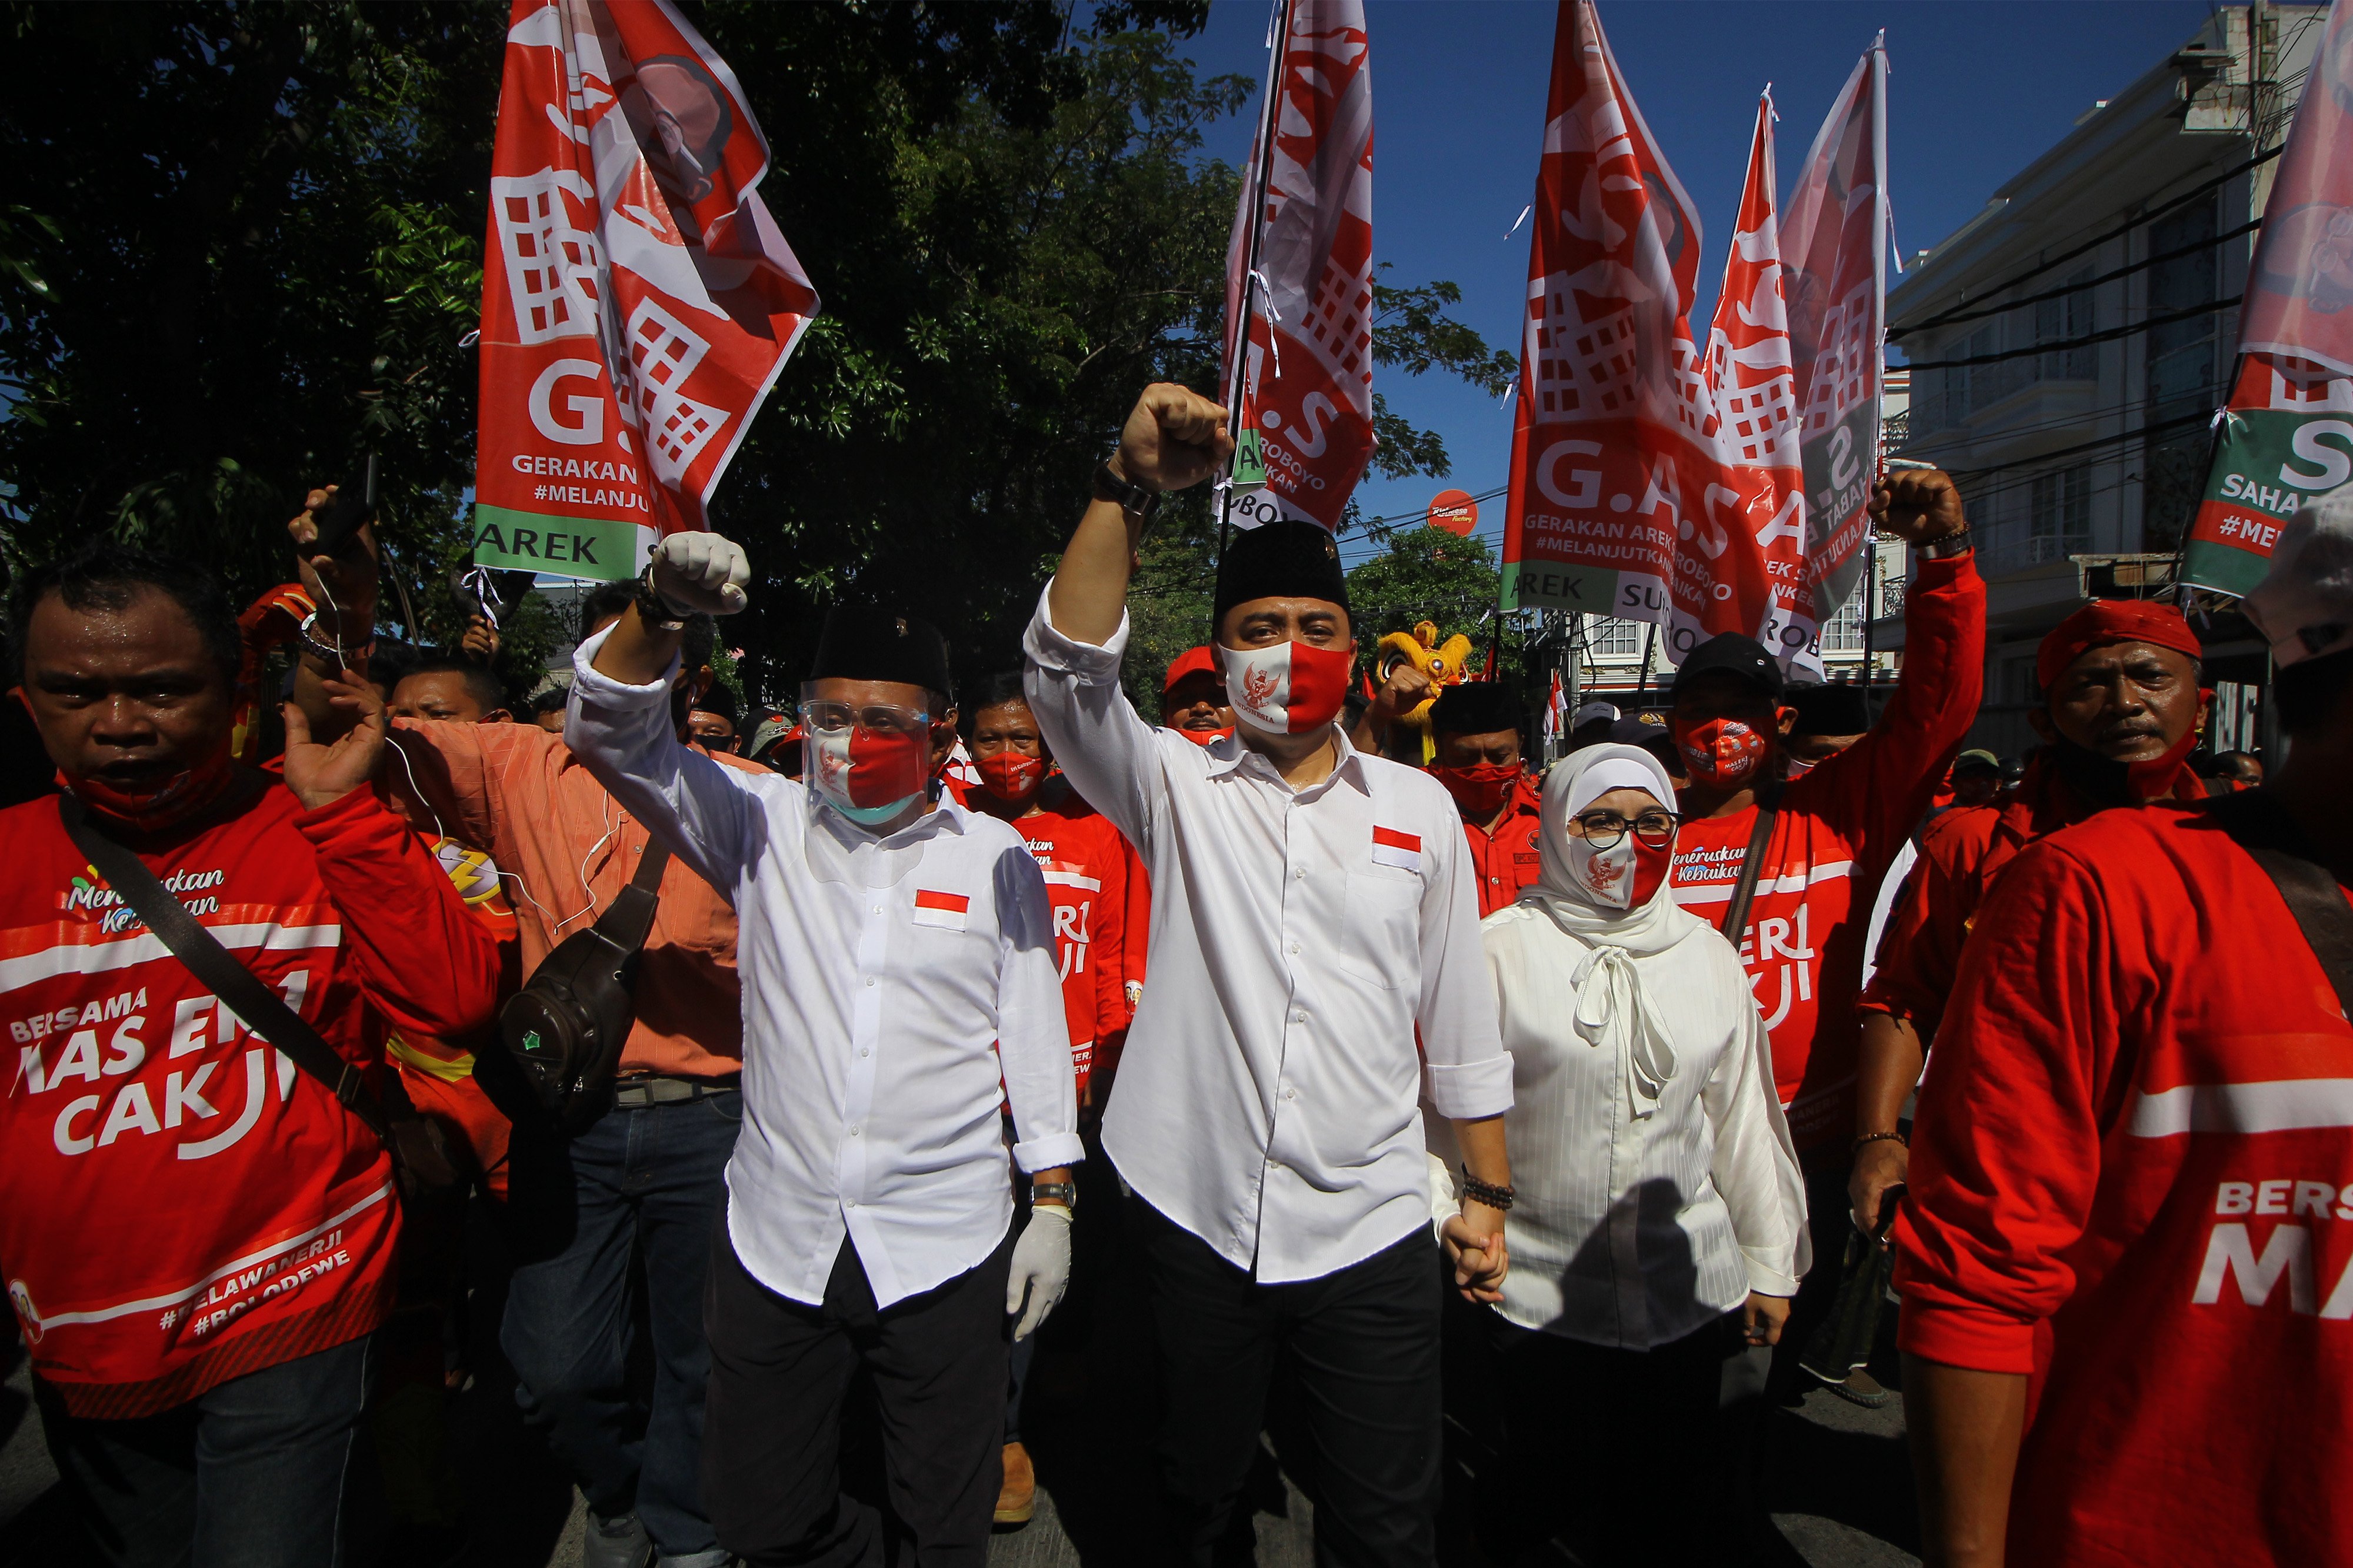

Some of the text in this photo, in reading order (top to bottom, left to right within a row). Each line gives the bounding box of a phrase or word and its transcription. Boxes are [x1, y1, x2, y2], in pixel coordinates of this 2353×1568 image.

[511, 454, 637, 485] GERAKAN
[534, 485, 649, 513] #MELANJU
[1535, 439, 1741, 560] G.A.S
[2220, 473, 2312, 516] SAHA
[475, 523, 599, 565] AREK
[1524, 514, 1624, 539] GERAKAN
[1629, 525, 1671, 552] AREK
[2219, 515, 2284, 549] #ME
[1509, 572, 1583, 600] AREK
[1764, 559, 1794, 578] EK
[1235, 699, 1275, 724] INDONESIA
[1672, 846, 1748, 866] eneruska
[68, 869, 224, 911] Menskan
[10, 986, 148, 1043] BERSAMA
[159, 1229, 343, 1330] #RELAWANERJI
